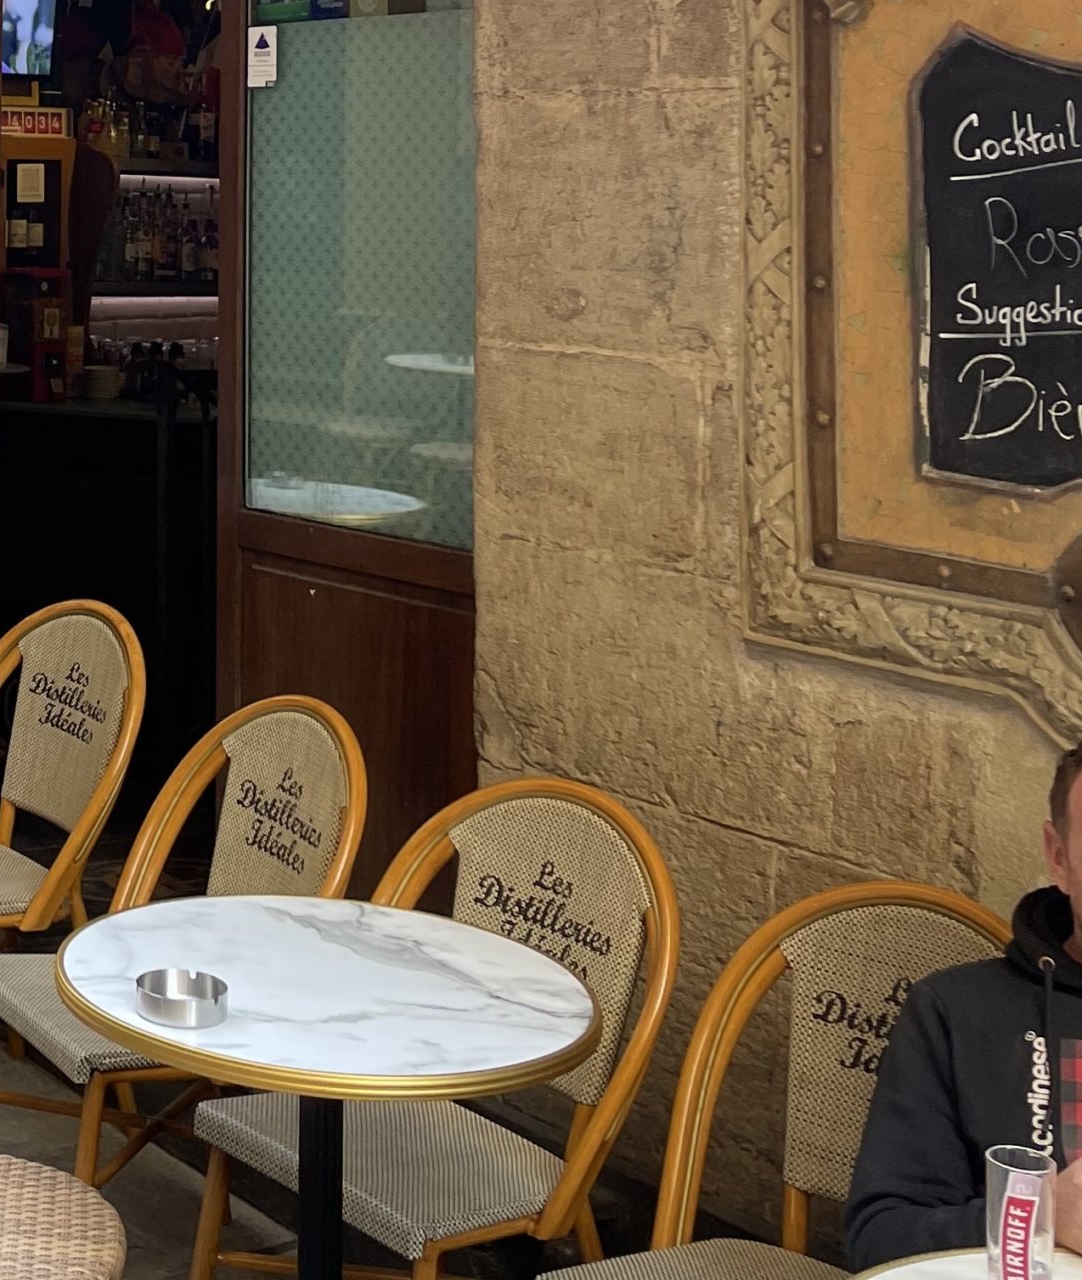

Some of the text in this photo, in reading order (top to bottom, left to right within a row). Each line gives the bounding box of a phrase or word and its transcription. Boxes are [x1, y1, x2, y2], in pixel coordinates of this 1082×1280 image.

[984, 196, 1082, 278] Ras
[29, 672, 106, 724] Distilleries
[65, 662, 89, 688] Les
[38, 703, 93, 745] Idéales
[276, 767, 303, 799] Les
[237, 779, 321, 848] Distilleries
[245, 818, 304, 875] Idéales
[533, 860, 573, 898] Les
[474, 875, 612, 956] Distilleries
[1004, 1205, 1029, 1280] IRNOFF
